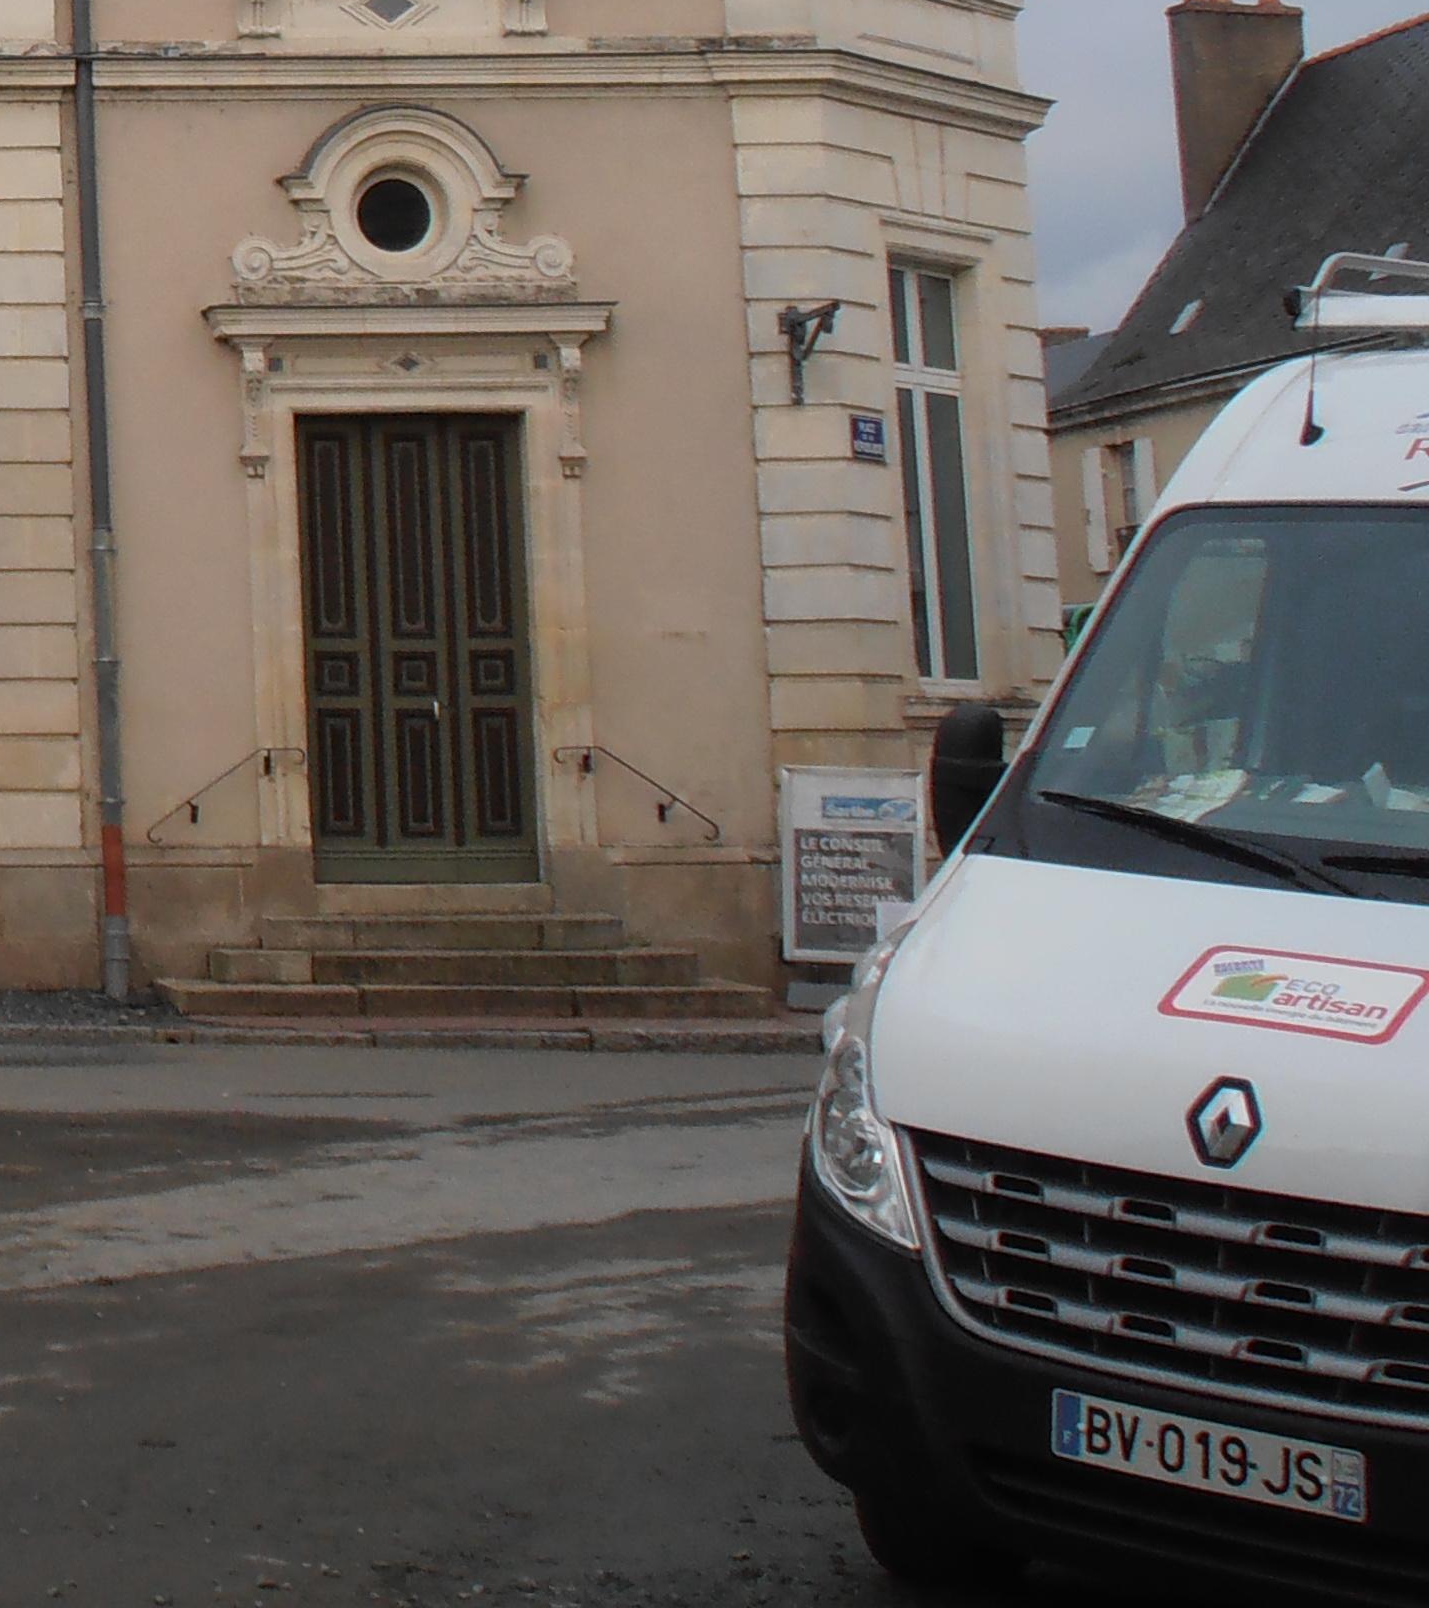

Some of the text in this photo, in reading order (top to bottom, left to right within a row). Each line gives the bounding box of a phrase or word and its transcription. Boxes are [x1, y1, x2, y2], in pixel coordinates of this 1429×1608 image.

[801, 837, 885, 853] LE CONSEIL
[801, 873, 895, 891] MODERNISE
[801, 892, 832, 907] VOS
[1284, 978, 1341, 996] ECO
[1272, 992, 1389, 1020] artisan
[1086, 1405, 1324, 1502] BV-019-JS
[1334, 1483, 1360, 1514] 72
